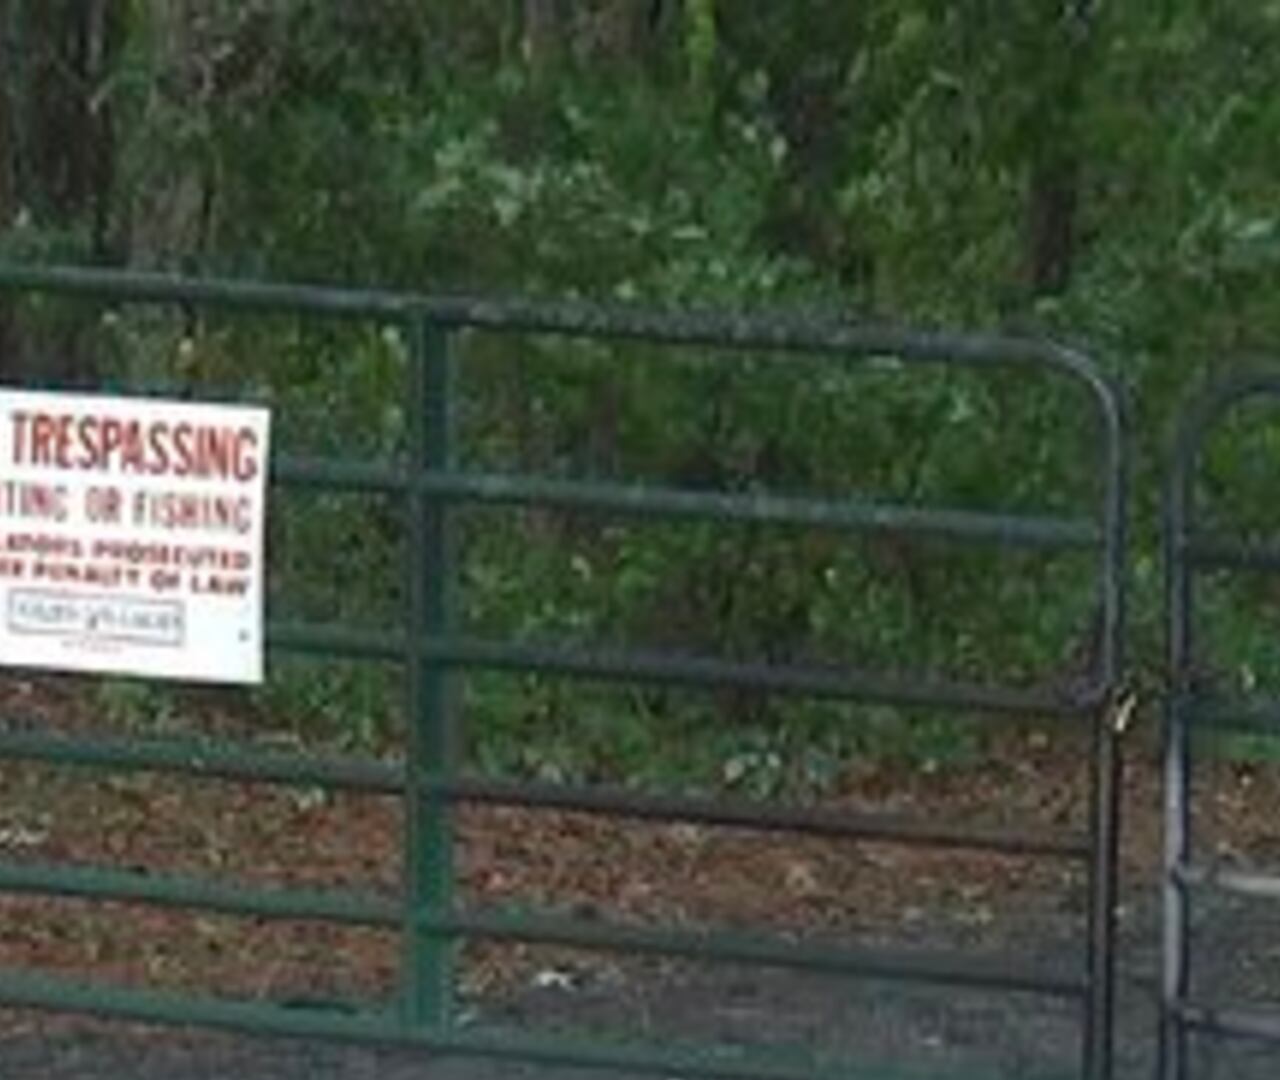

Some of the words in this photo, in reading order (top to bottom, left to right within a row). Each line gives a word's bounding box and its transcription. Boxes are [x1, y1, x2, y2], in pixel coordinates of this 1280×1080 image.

[10, 411, 258, 482] TRESPASSING
[85, 485, 123, 523] OR
[132, 491, 251, 535] FISHING
[92, 538, 251, 569] PROSECUTED
[32, 561, 140, 588] PENALTY
[150, 569, 181, 592] OF
[191, 576, 249, 596] LAW
